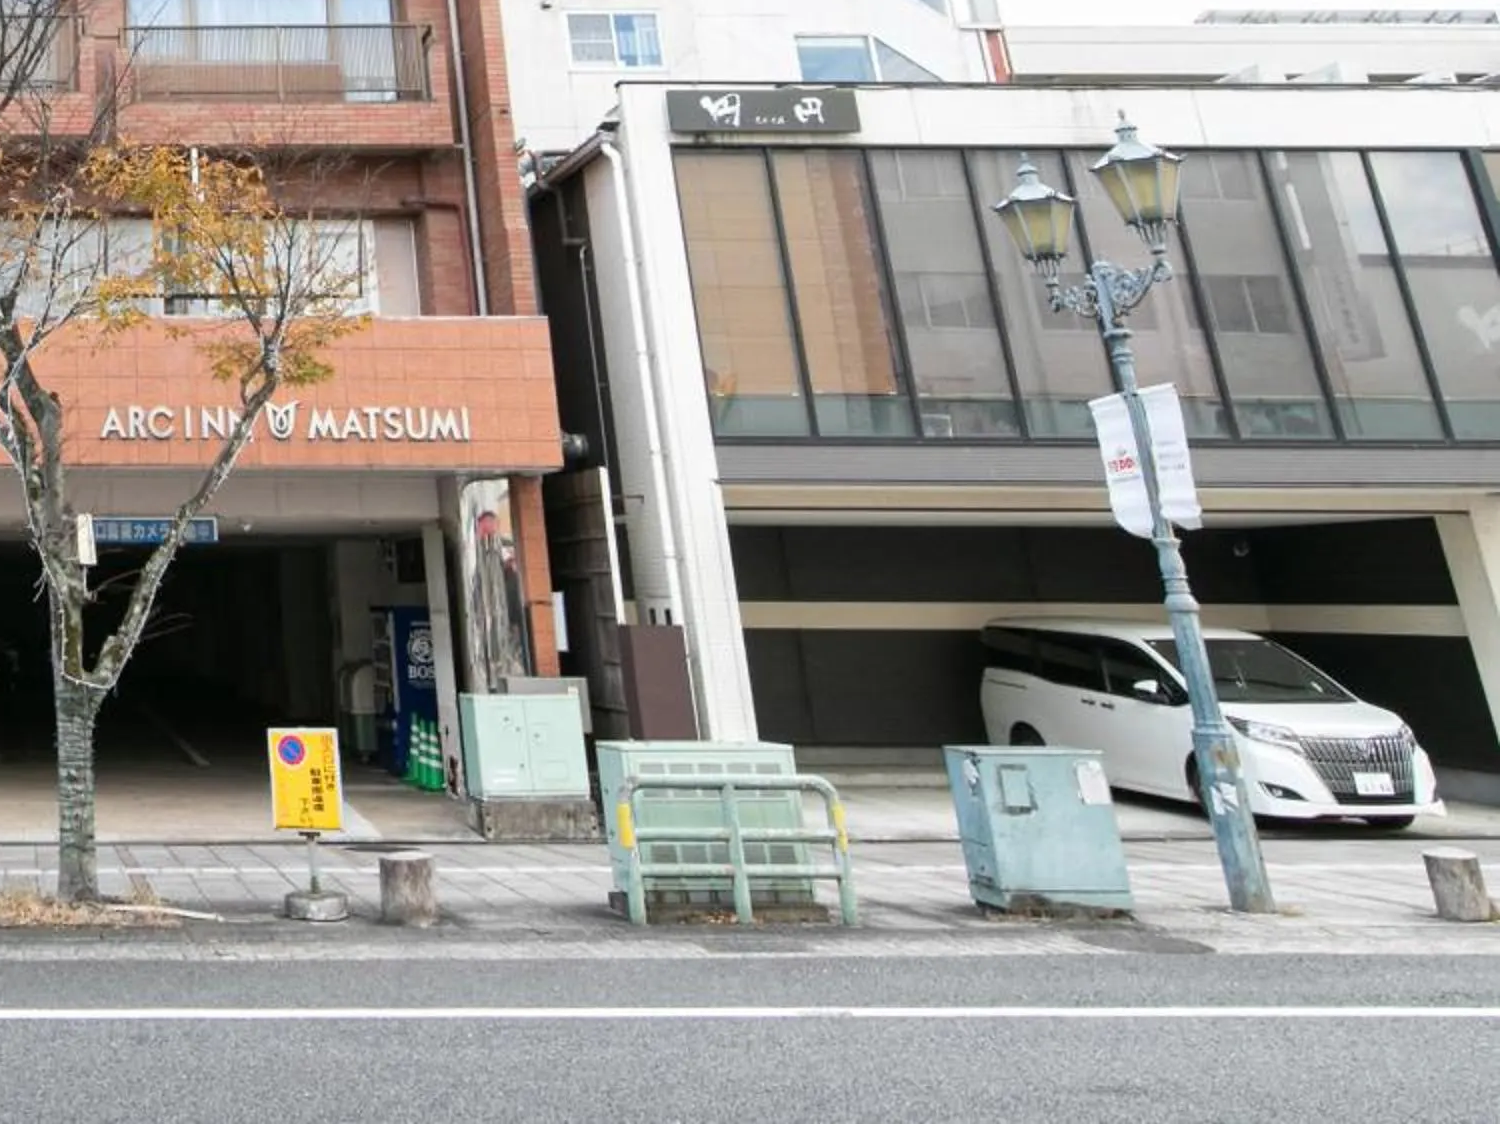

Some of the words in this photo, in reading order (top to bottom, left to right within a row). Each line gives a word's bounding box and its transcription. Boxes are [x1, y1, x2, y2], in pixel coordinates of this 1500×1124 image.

[100, 405, 175, 440] ARC
[307, 406, 470, 442] MATSUMI
[407, 665, 436, 679] BOS
